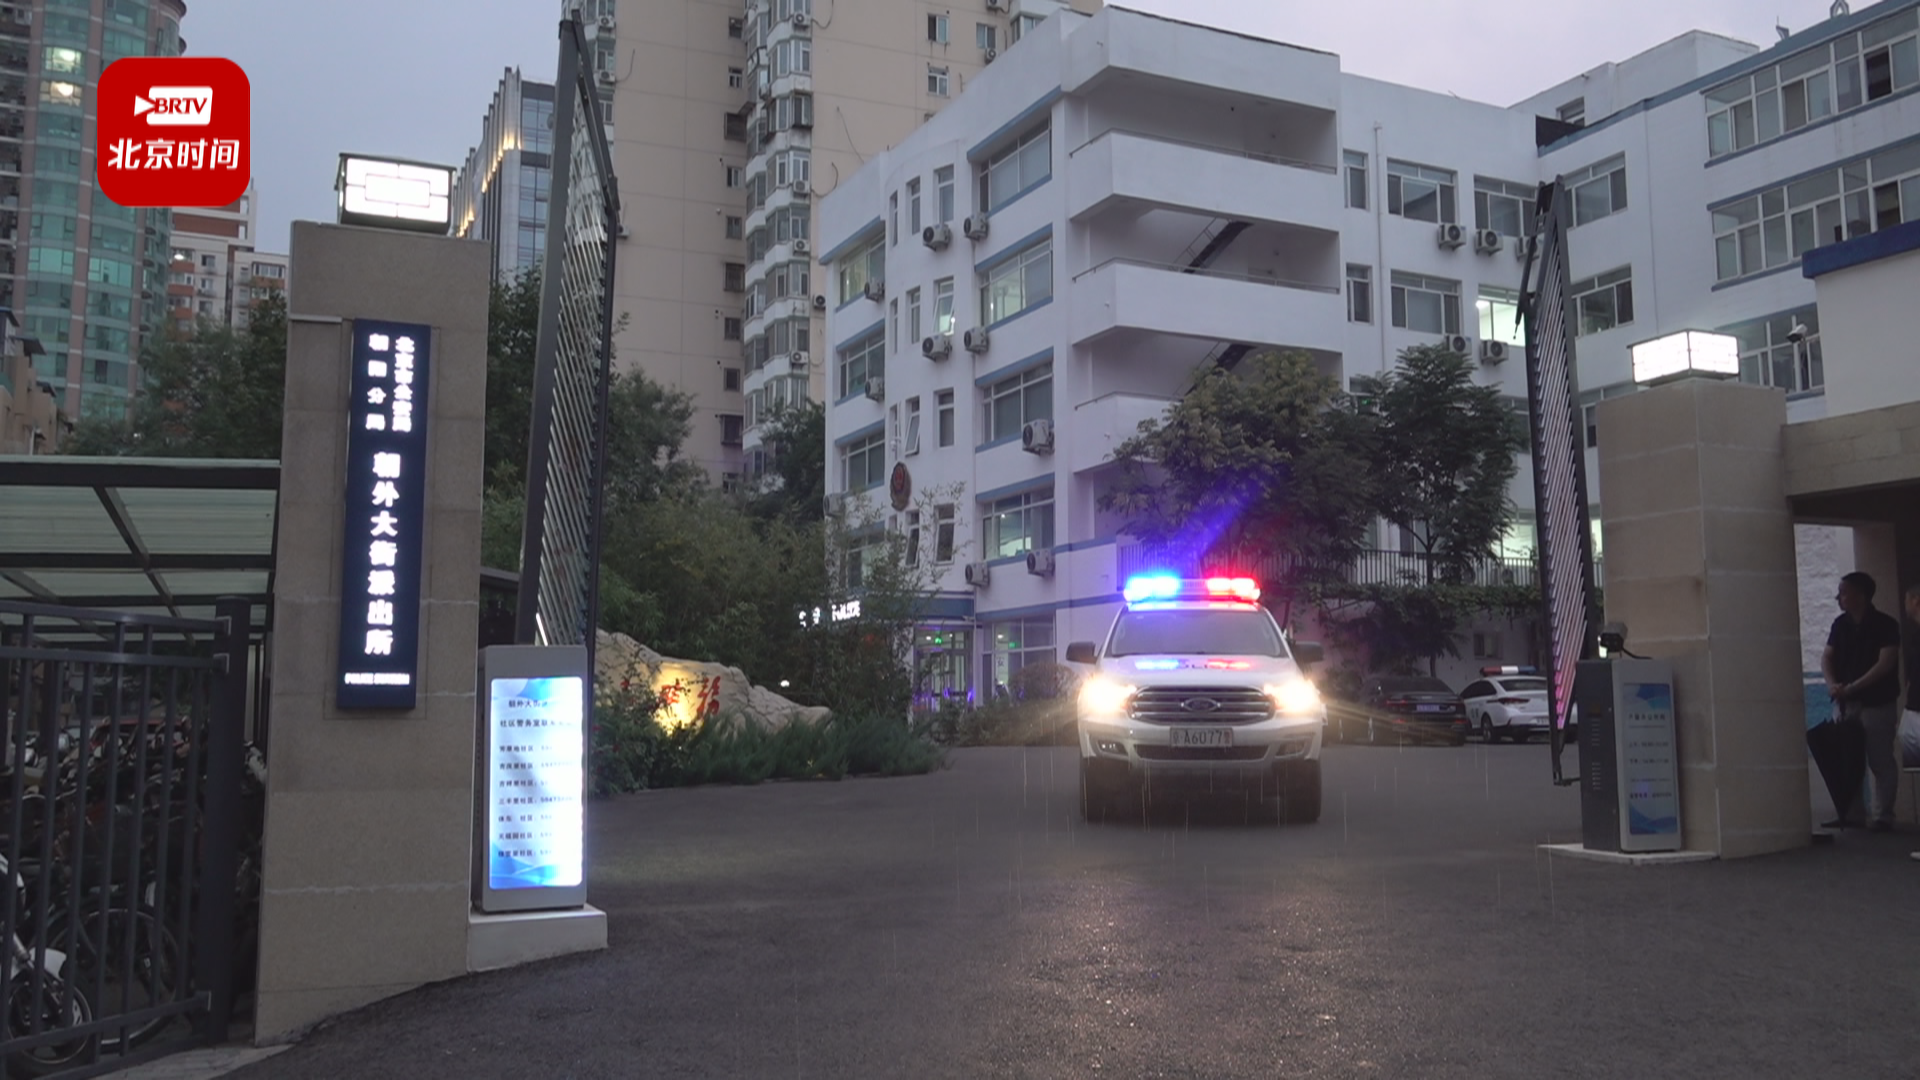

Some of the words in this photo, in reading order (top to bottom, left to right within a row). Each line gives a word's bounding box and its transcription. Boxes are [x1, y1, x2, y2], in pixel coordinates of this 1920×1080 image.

[364, 452, 401, 656] 朝外大街派出所
